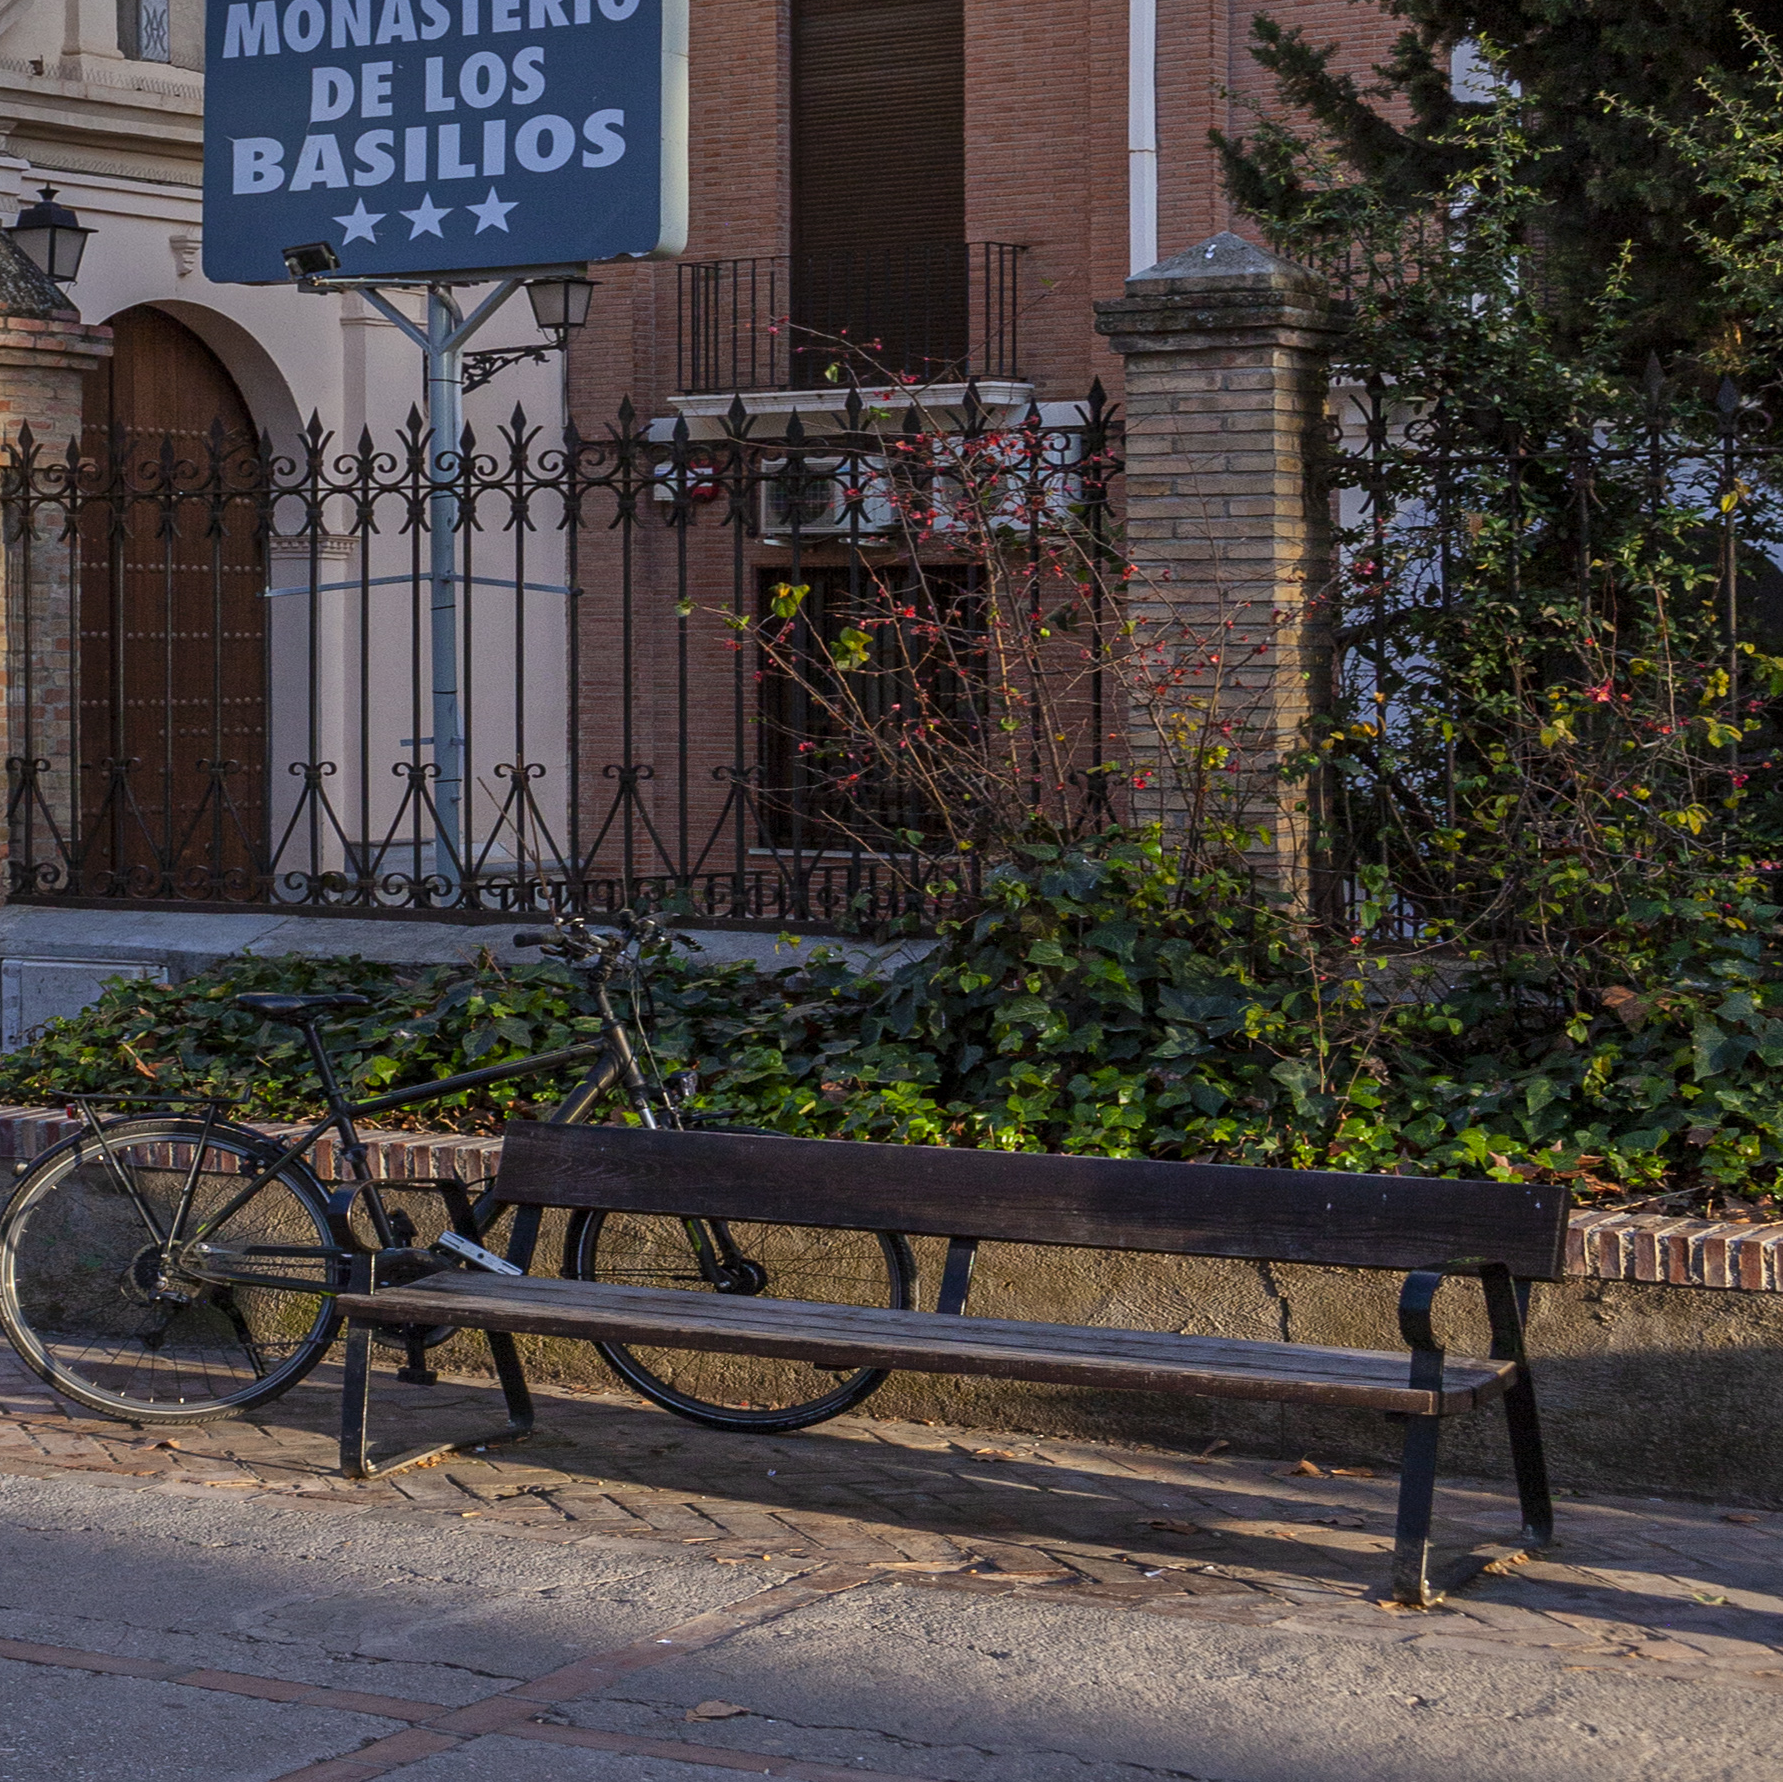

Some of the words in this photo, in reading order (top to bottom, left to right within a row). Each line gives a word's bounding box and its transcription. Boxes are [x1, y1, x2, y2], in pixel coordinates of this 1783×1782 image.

[310, 61, 395, 123] DE
[424, 46, 546, 113] LOS
[230, 108, 626, 196] BASILIOS
